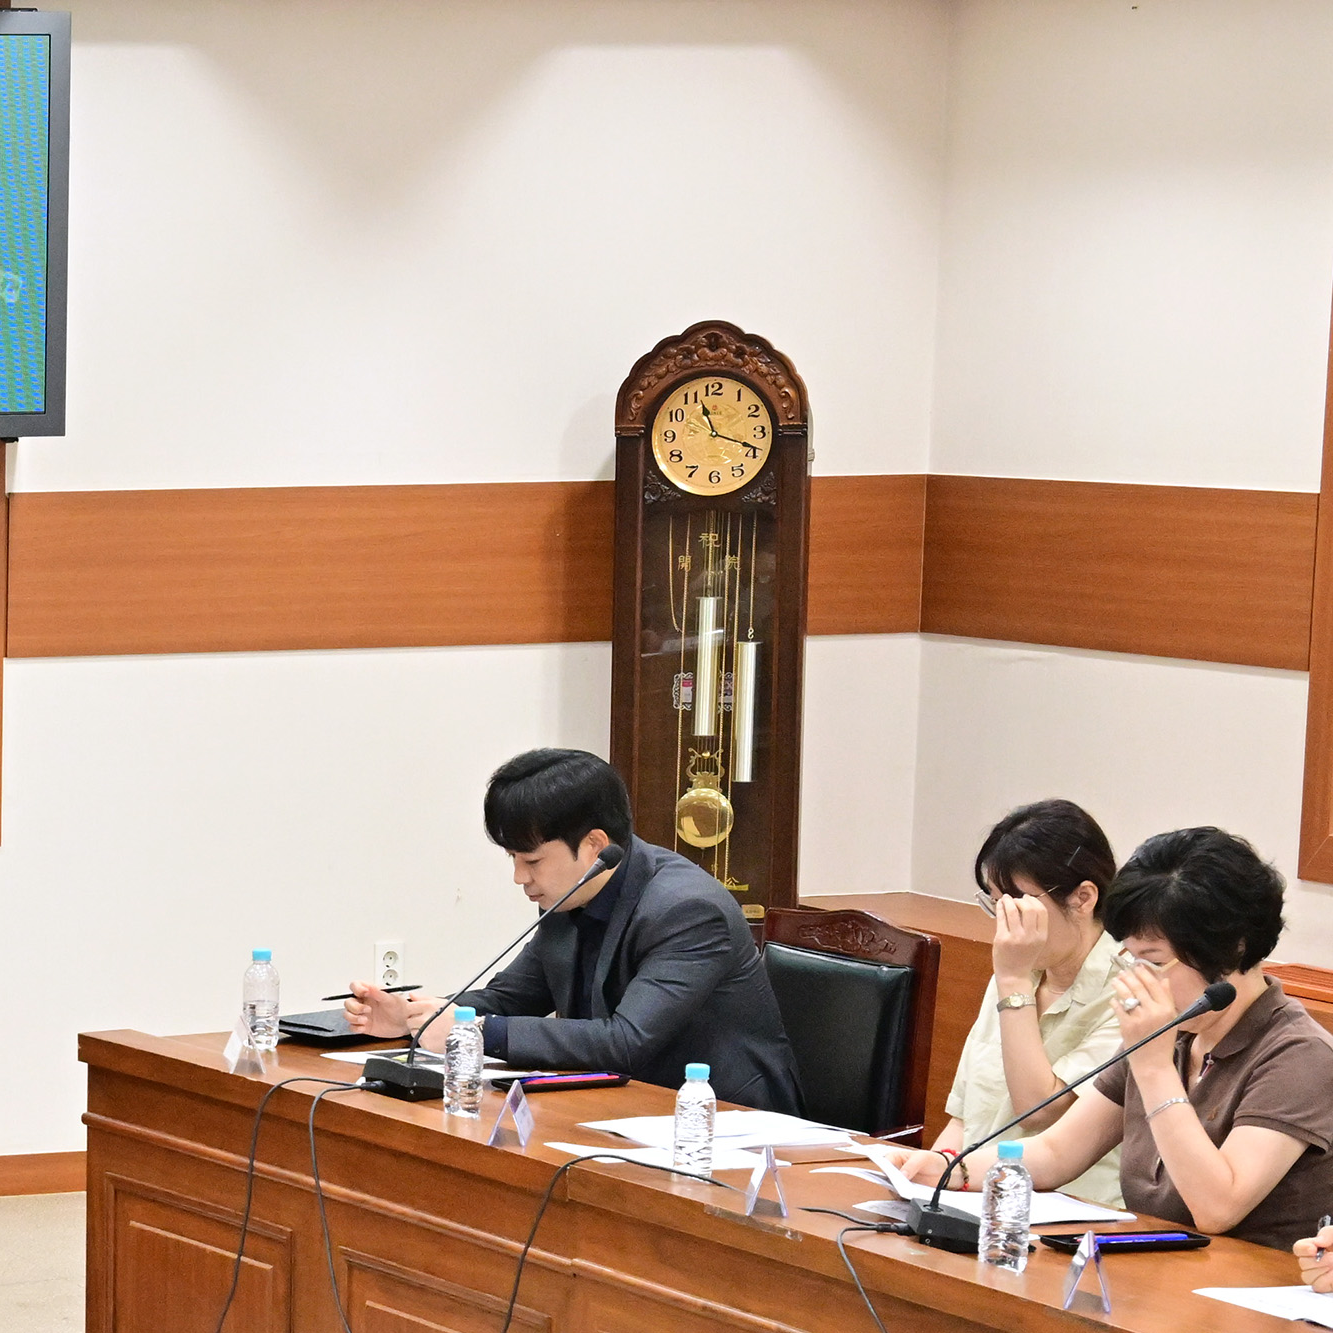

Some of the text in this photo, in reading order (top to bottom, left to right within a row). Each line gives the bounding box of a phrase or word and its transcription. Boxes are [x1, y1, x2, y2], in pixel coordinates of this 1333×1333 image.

[704, 382, 724, 397] 12
[736, 388, 742, 402] 1
[684, 391, 698, 405] 11
[669, 408, 685, 422] 10
[747, 404, 761, 418] 2
[663, 430, 676, 443] 9
[753, 425, 766, 439] 3
[669, 449, 683, 463] 8
[745, 446, 759, 459] 4
[685, 465, 699, 478] 7
[708, 470, 721, 484] 6
[731, 463, 745, 477] 5
